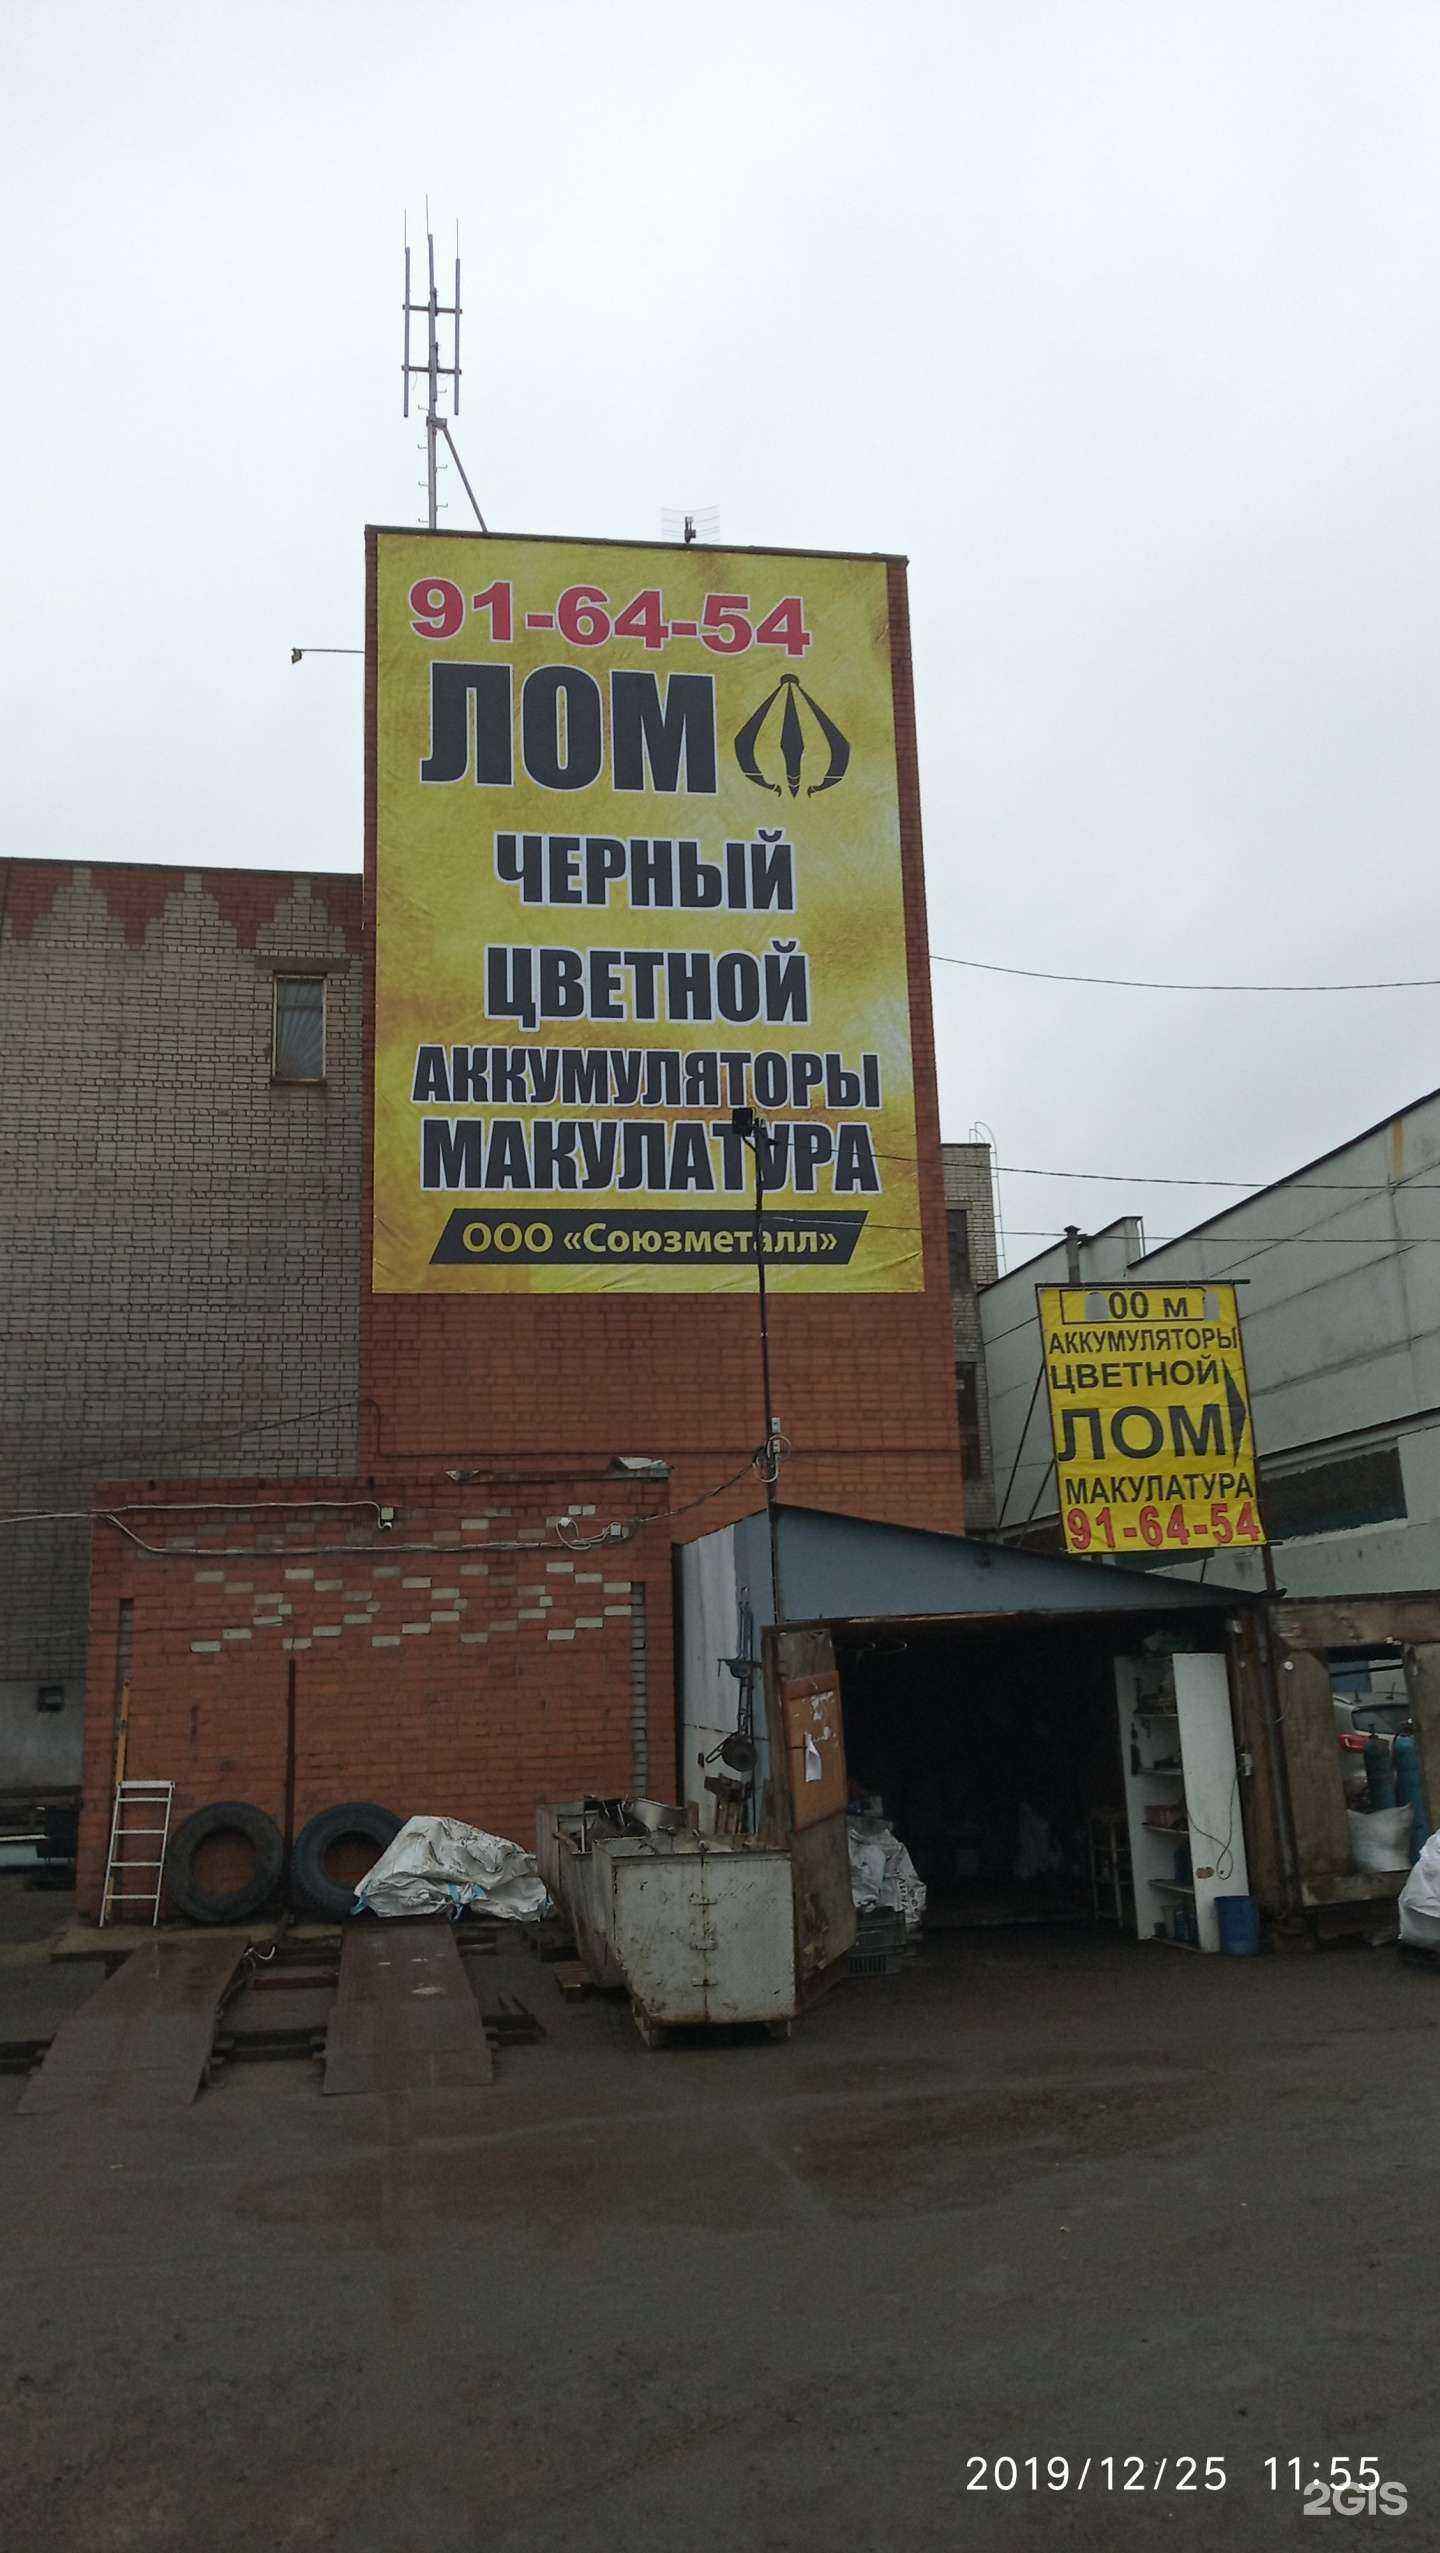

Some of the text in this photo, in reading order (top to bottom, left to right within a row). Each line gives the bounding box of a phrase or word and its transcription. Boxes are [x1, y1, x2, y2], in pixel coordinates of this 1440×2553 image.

[408, 577, 812, 657] 91-64-54
[419, 661, 718, 794] ЛОМ
[494, 828, 796, 912] ЧЕРНЫЙ
[484, 938, 811, 1031] ЦВЕТНОЙ
[411, 1044, 882, 1110] АККУМУЛЯТОРЫ
[421, 1116, 883, 1193] МАКУЛАТУРА
[462, 1221, 838, 1254] ООО «Союзметалл»
[1049, 1326, 1238, 1354] АККУМУЛЯТОРЫ
[1051, 1354, 1219, 1394] ЦВЕТНОЙ
[1058, 1403, 1227, 1462] ЛОМ
[1065, 1472, 1254, 1504] МАКУЛАТУРА
[1067, 1502, 1261, 1550] 91-64-54
